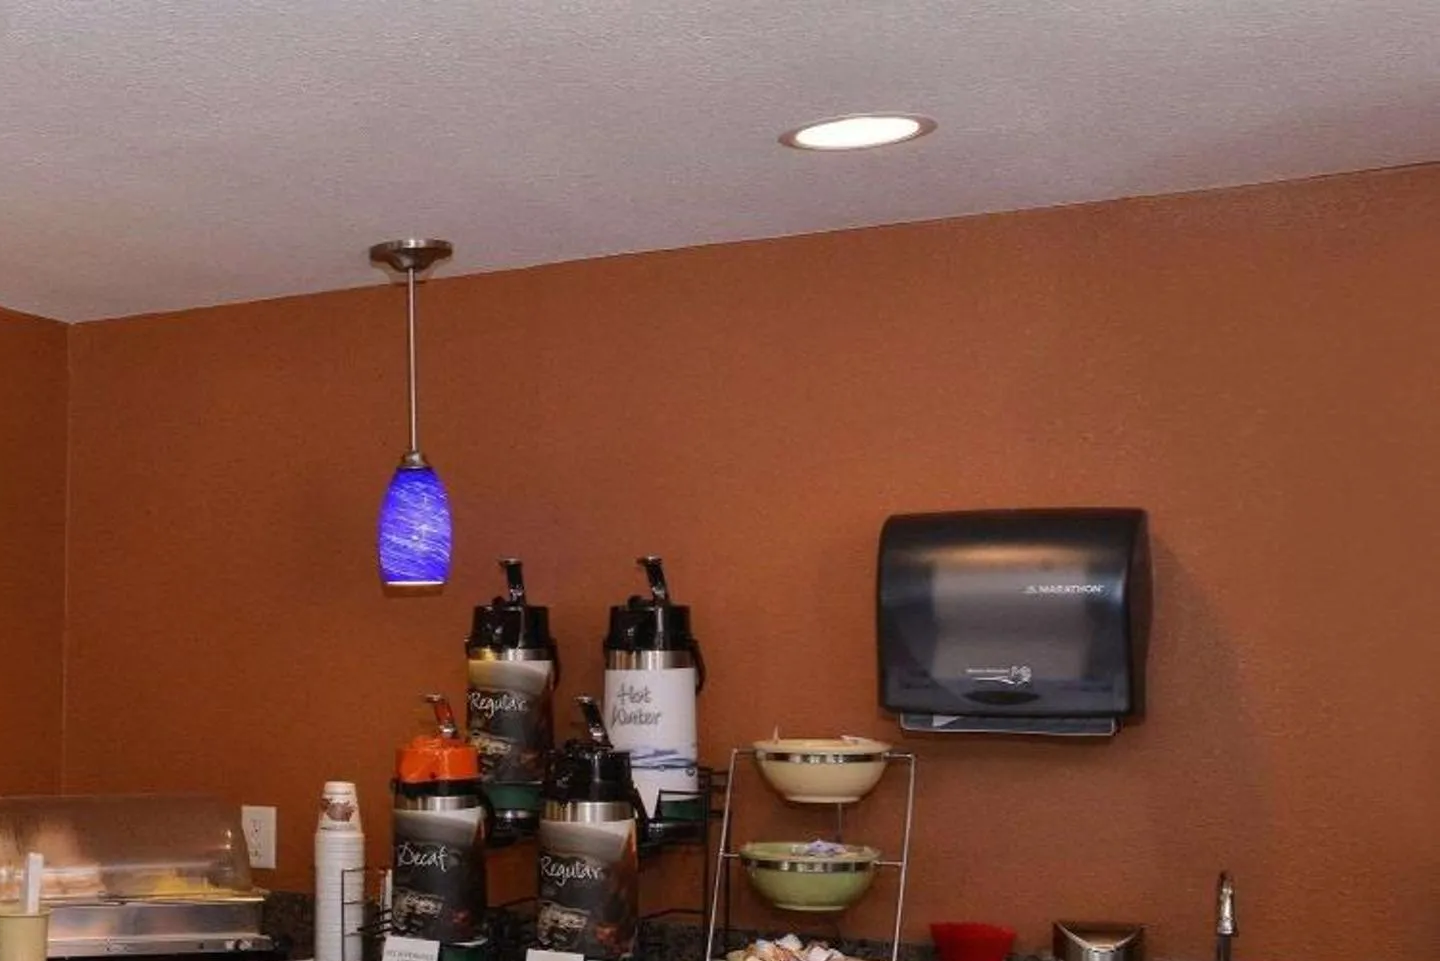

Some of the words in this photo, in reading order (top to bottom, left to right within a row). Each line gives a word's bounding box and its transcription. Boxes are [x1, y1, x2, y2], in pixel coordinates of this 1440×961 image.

[1038, 584, 1105, 595] MARATHON
[467, 691, 527, 720] Regular
[616, 683, 653, 706] Hot
[398, 842, 447, 873] Decaf
[540, 856, 603, 887] Regular
